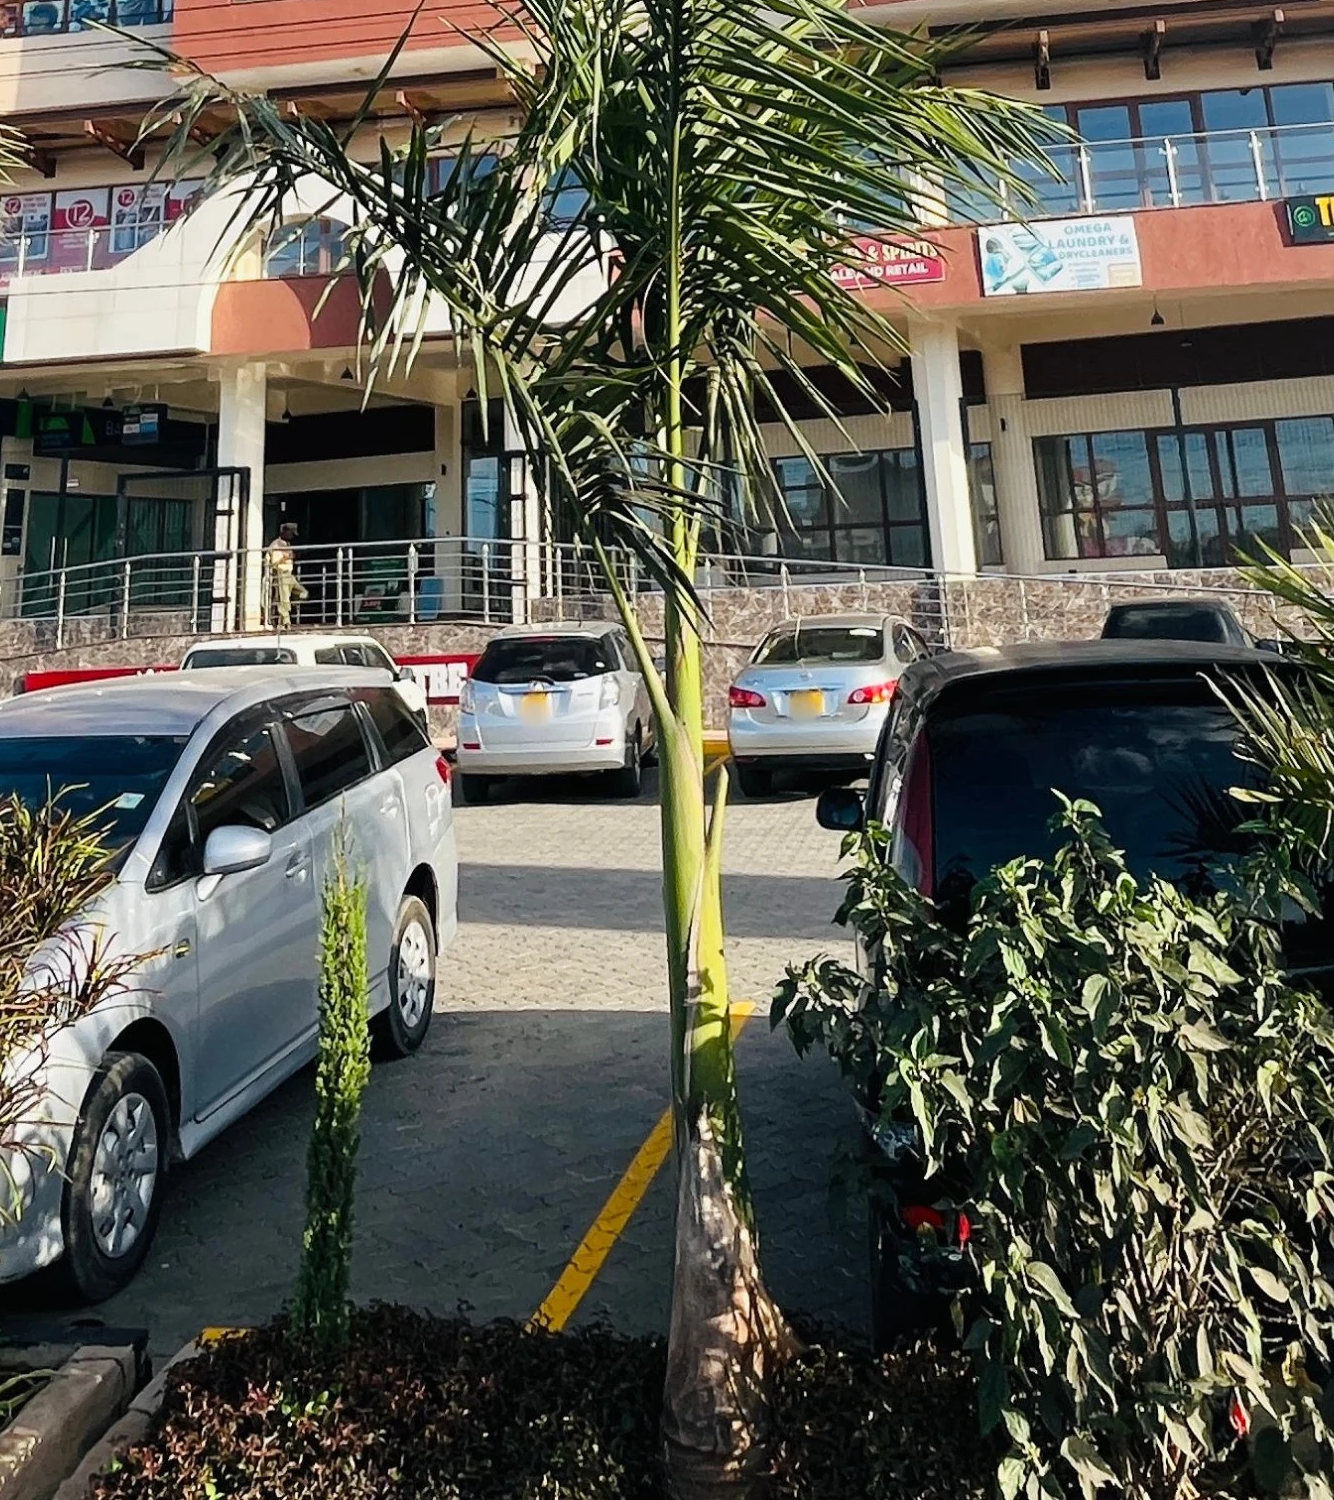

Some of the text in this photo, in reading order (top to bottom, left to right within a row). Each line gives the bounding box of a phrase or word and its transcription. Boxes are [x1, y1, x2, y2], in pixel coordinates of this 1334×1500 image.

[1064, 222, 1112, 235] OMEGA
[1048, 234, 1129, 250] LAUNDRY &
[1058, 246, 1133, 260] DRYCLEANERS
[886, 262, 929, 277] RETAIL
